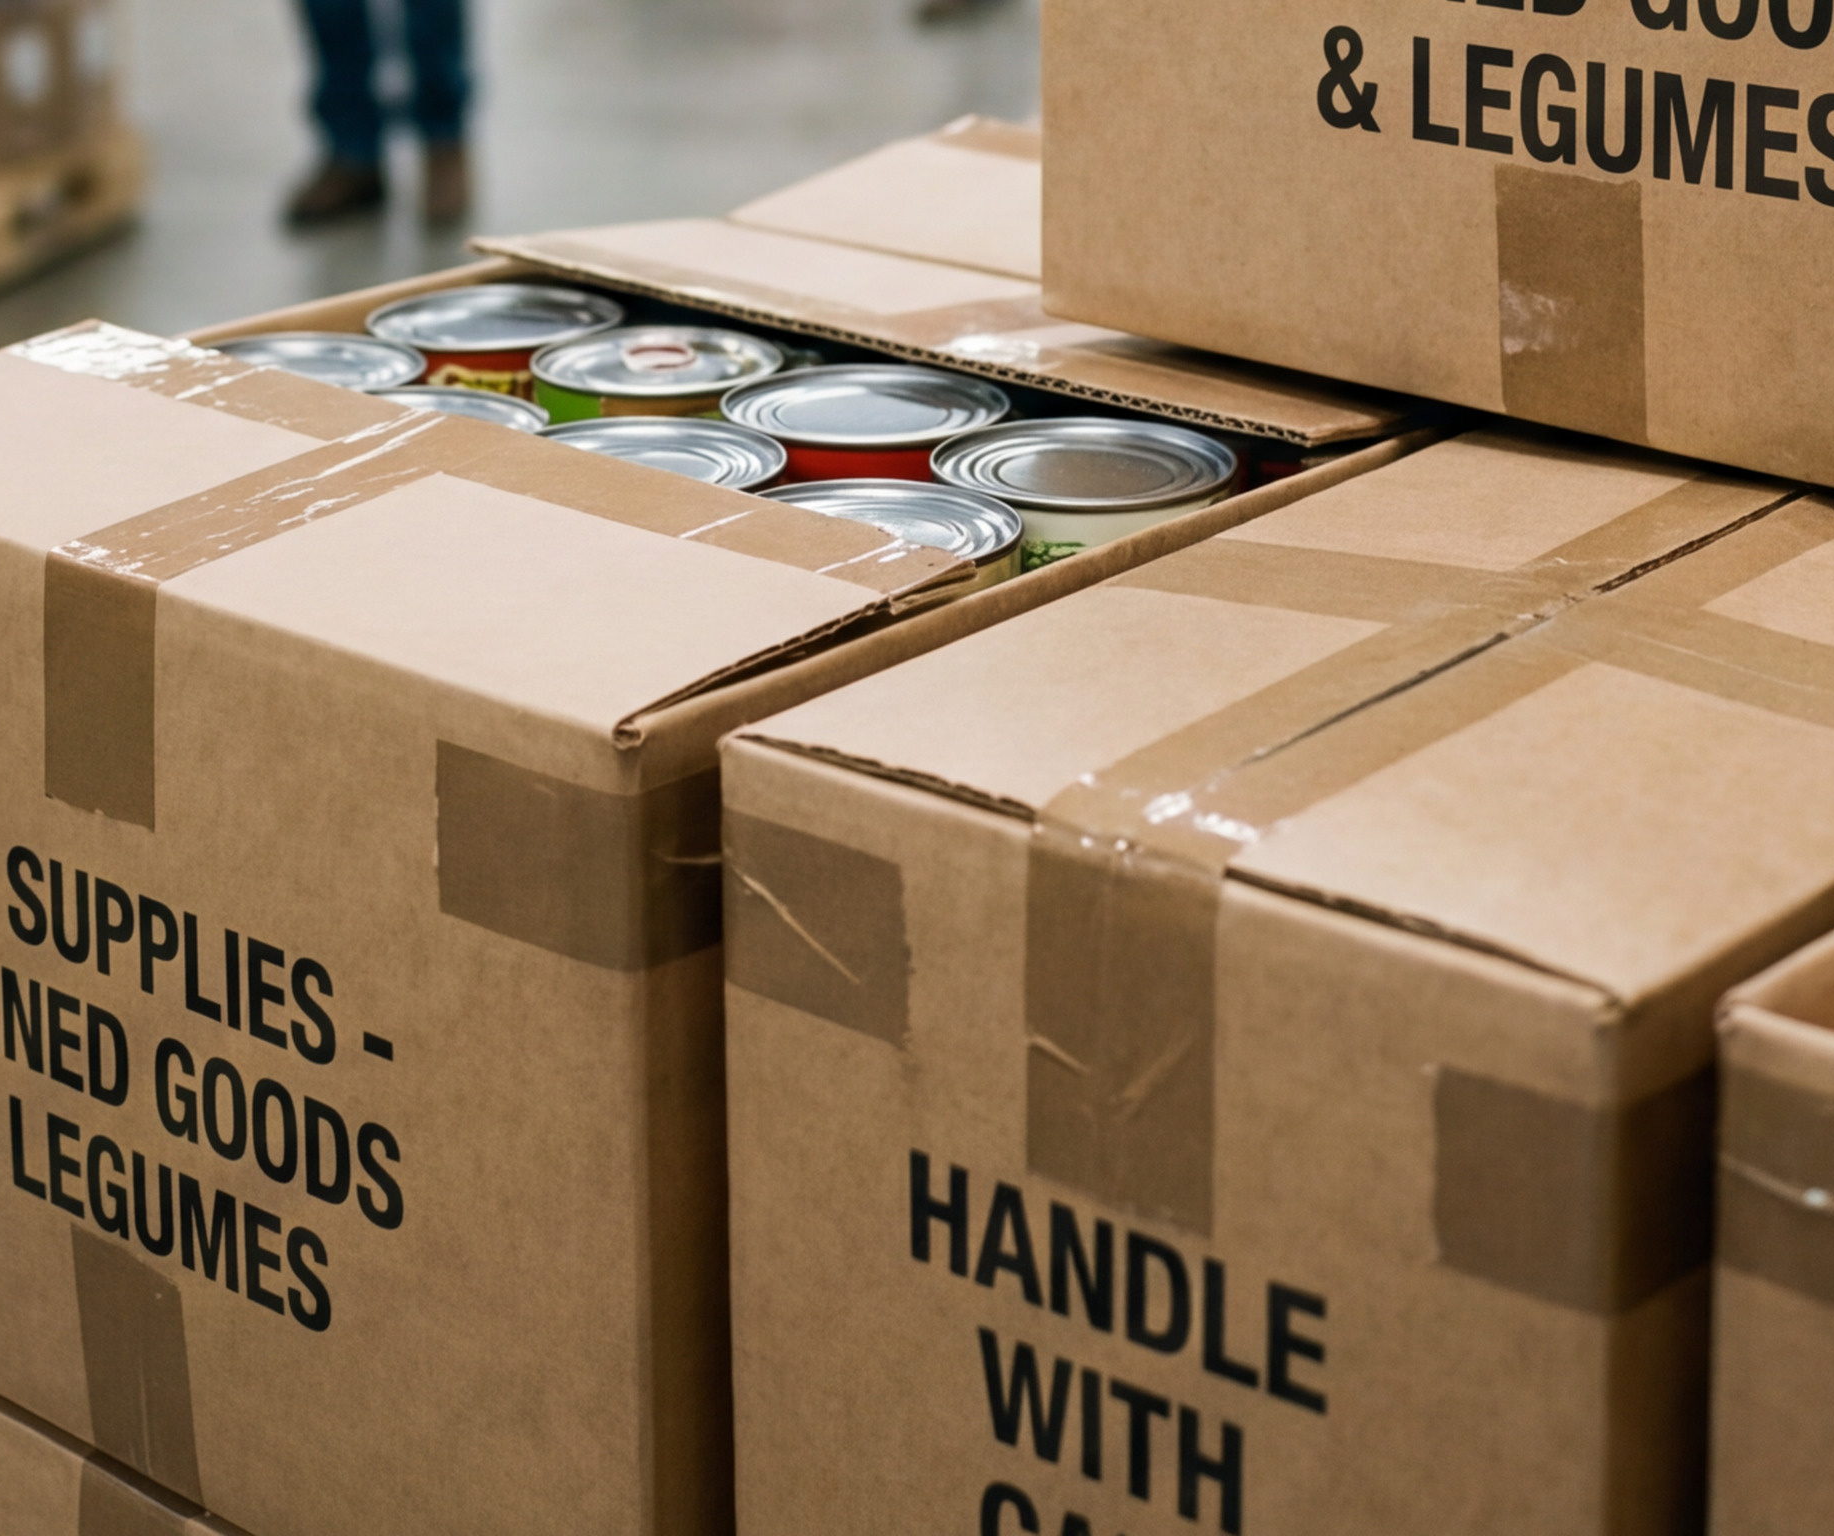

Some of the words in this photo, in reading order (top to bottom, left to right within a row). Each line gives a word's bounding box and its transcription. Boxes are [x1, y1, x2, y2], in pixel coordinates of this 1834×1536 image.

[1317, 25, 1381, 133] &
[6, 845, 336, 1065] SUPPLIES
[363, 1031, 395, 1062] -
[9, 1095, 332, 1333] LEGUMES
[154, 1037, 404, 1230] GOODS
[909, 1148, 1327, 1415] HANDLE
[978, 1326, 1244, 1536] WITH
